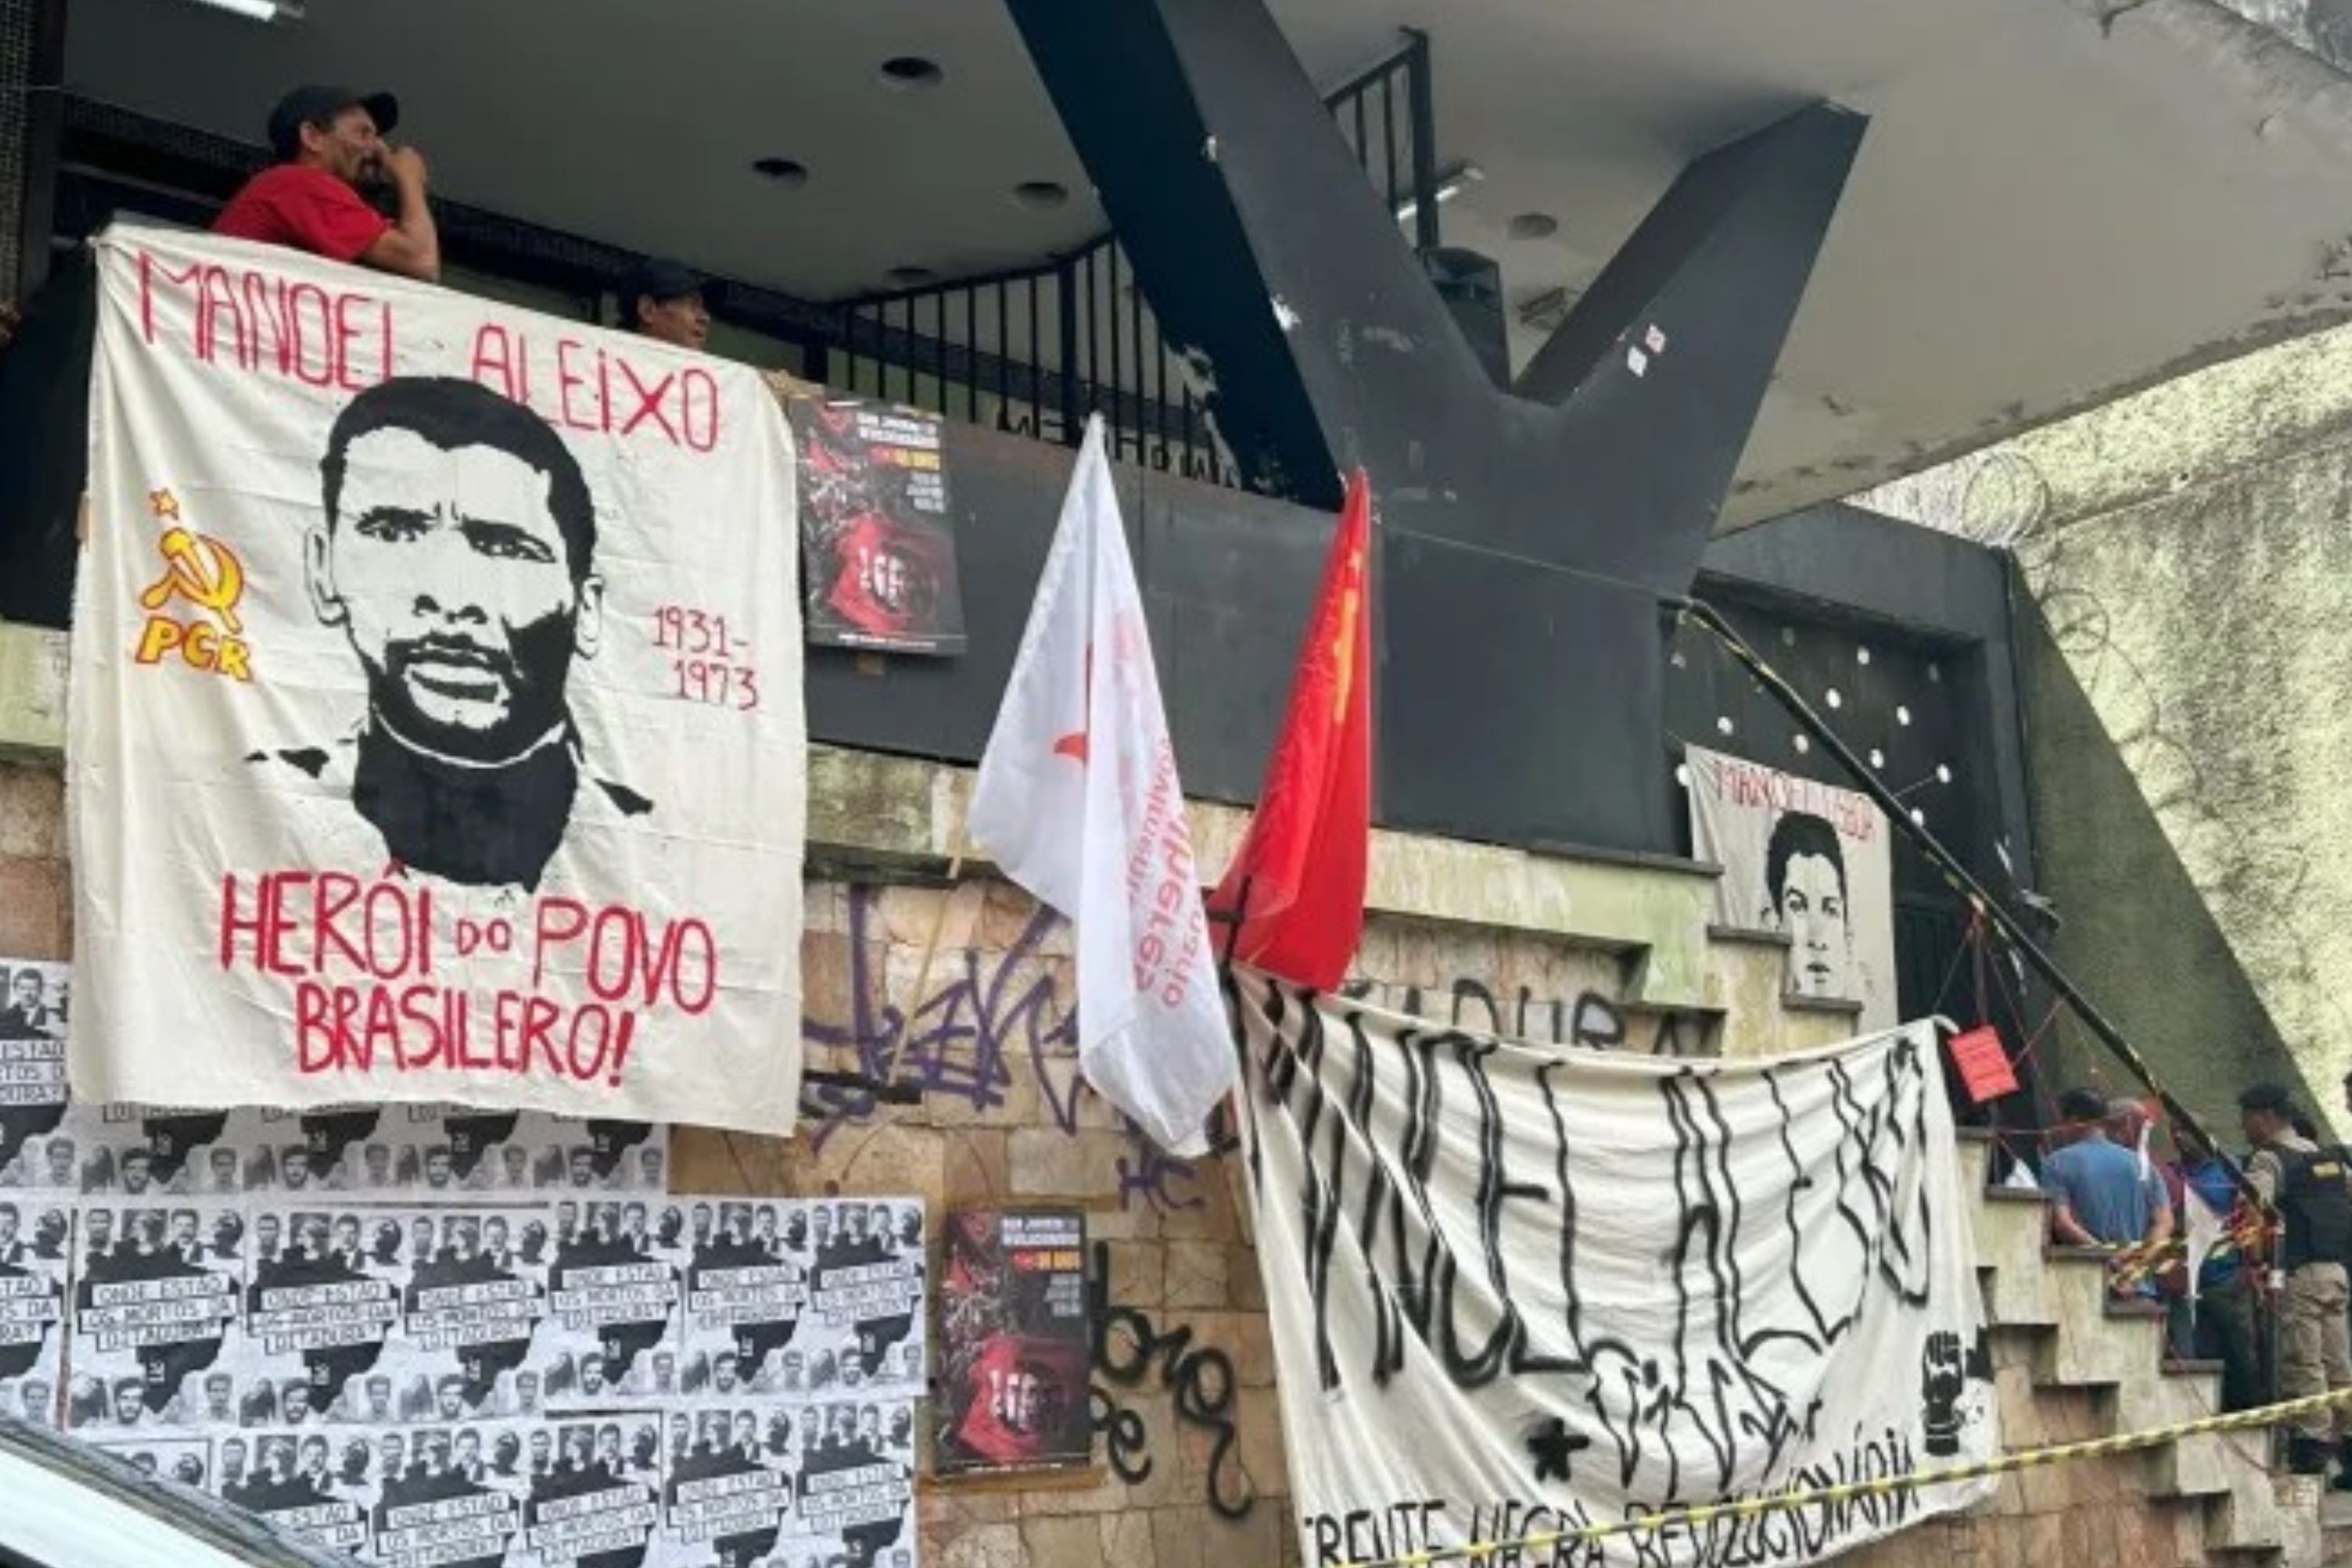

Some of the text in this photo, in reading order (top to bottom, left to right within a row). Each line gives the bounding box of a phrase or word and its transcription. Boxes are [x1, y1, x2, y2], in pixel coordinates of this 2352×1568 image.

[139, 250, 720, 453] MANOEL ALEIXO
[135, 615, 254, 682] PCR
[652, 605, 750, 657] 1931-
[673, 659, 760, 710] 1973
[535, 898, 717, 1014] POVO
[295, 982, 636, 1087] BRASILERO!
